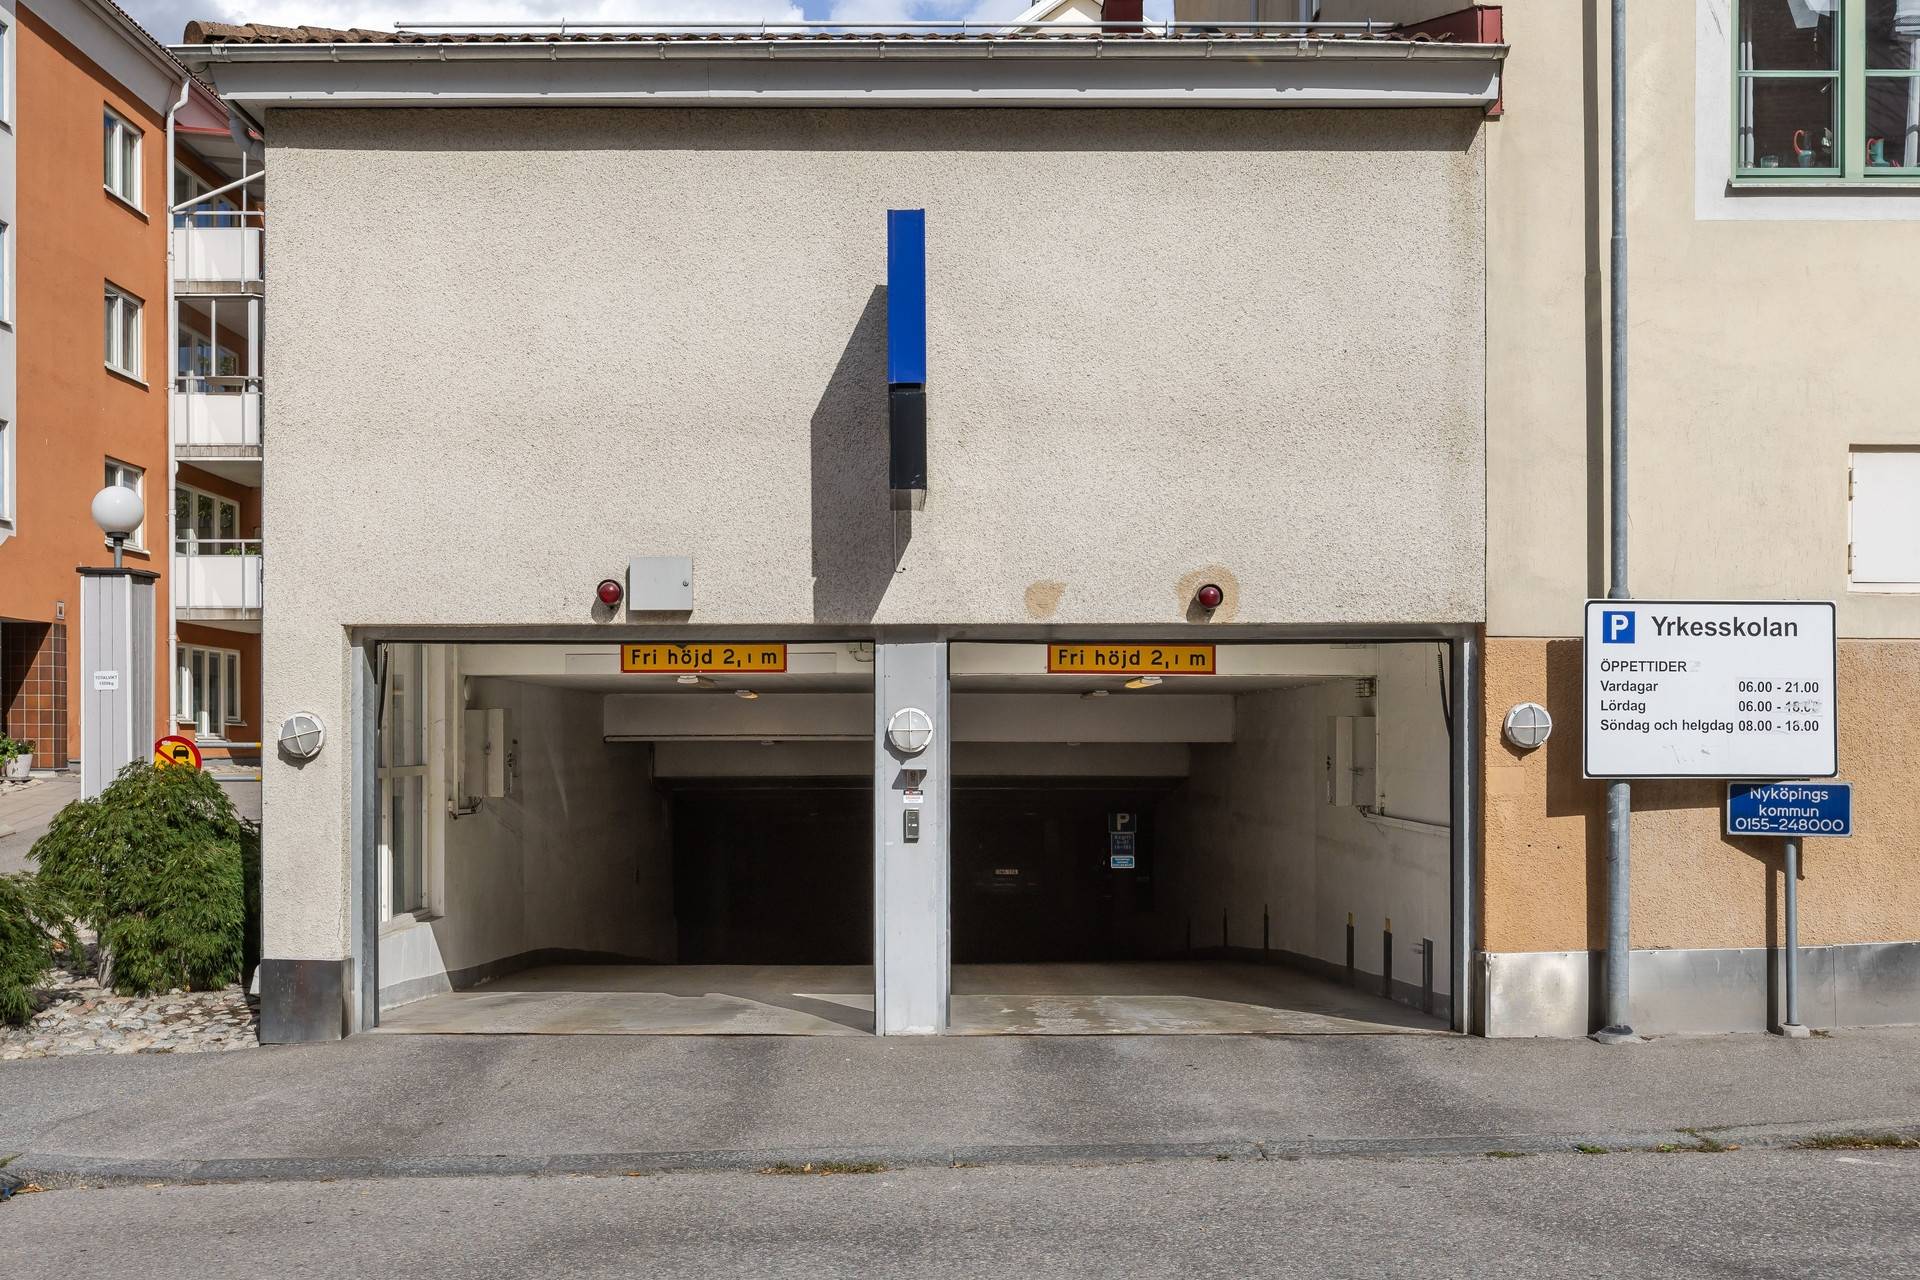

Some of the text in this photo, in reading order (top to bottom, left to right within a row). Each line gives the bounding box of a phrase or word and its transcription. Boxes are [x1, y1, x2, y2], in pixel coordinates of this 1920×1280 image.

[1611, 615, 1629, 641] P
[1650, 615, 1799, 638] Yrkesskolan
[631, 648, 657, 665] Fri
[668, 648, 713, 668] höjd
[761, 652, 777, 665] m
[1058, 649, 1084, 665] Fri
[1095, 649, 1141, 669] höjd
[1190, 653, 1206, 666] m
[1600, 659, 1687, 672] ÖPPETTIDER
[1600, 680, 1659, 694] Vardagar
[1738, 681, 1773, 693] 06.00
[1784, 681, 1820, 693] 21.00
[1600, 699, 1646, 713] Lördag
[1738, 700, 1773, 713] 06.00
[1600, 719, 1650, 733] Söndag
[1654, 719, 1678, 732] och
[1682, 719, 1734, 733] helgdag
[1738, 720, 1773, 732] 08.00
[1750, 787, 1829, 803] Nyköpings
[1758, 805, 1819, 817] kommun
[1735, 817, 1845, 831] 0155-248000
